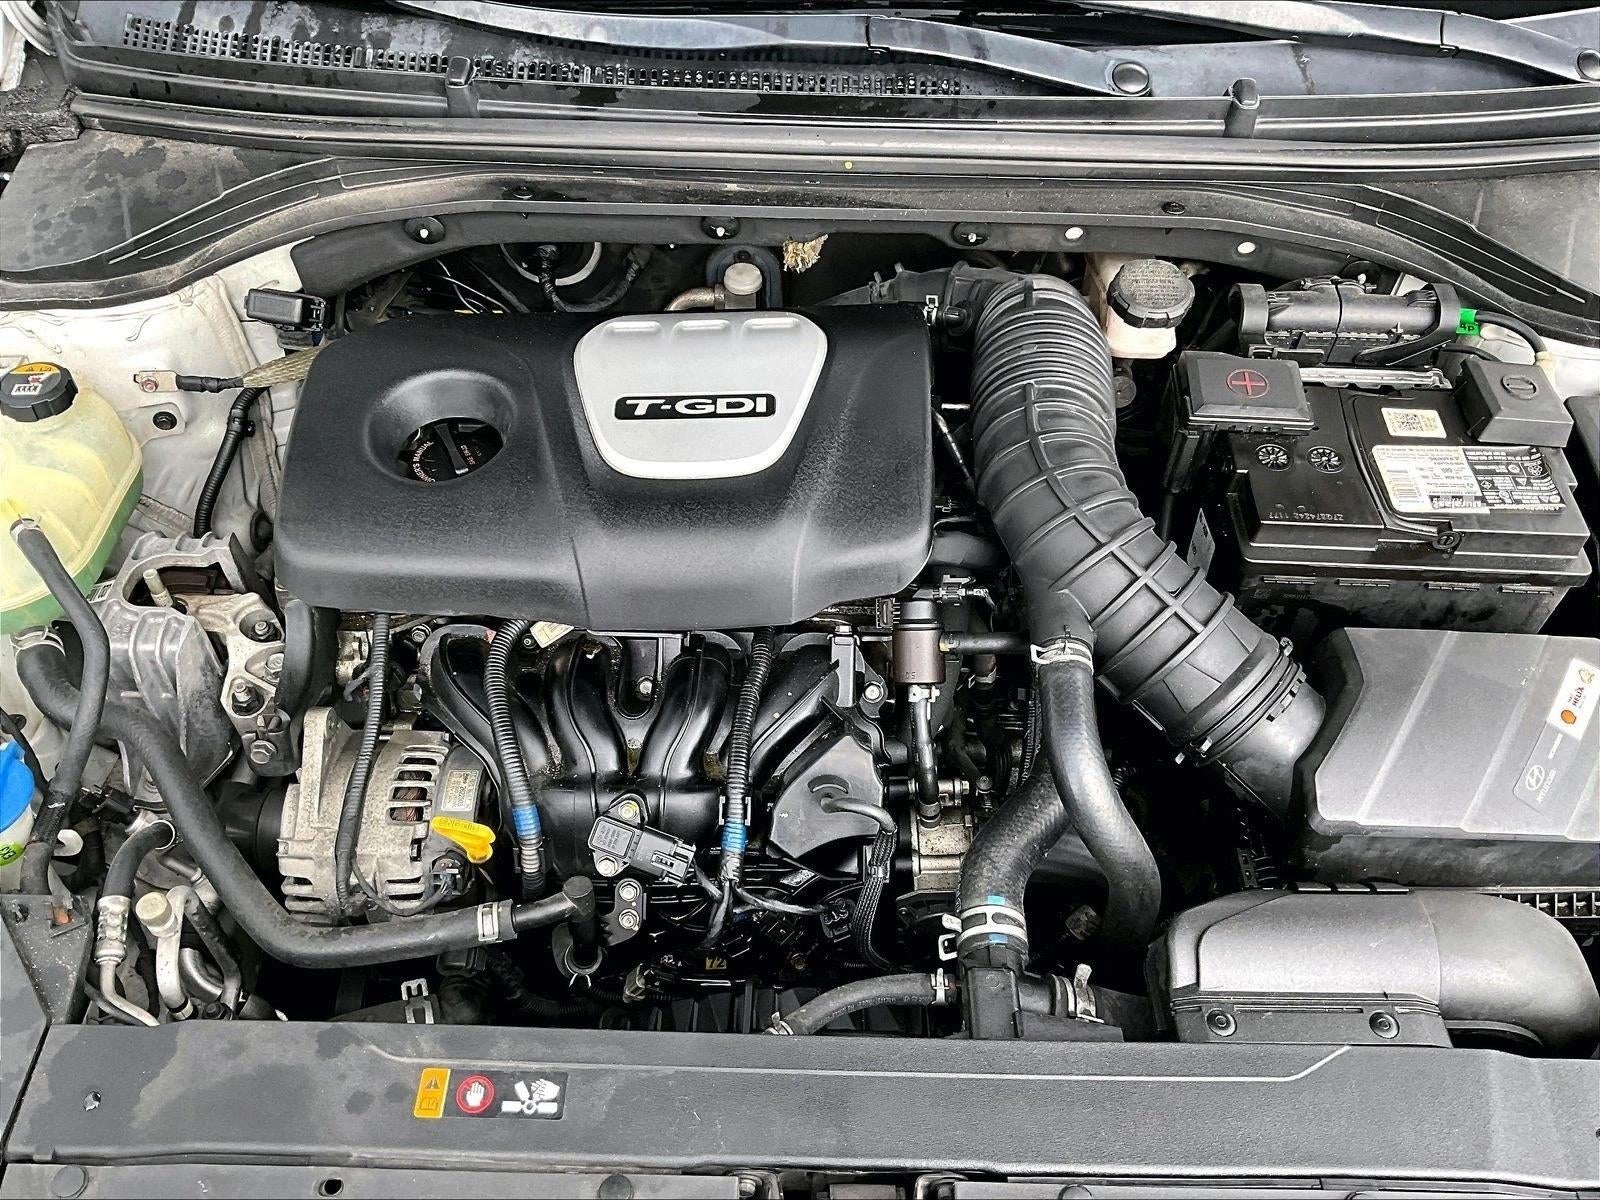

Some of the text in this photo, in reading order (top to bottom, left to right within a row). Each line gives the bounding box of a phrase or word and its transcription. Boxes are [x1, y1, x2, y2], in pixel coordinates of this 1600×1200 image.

[625, 396, 767, 416] T-GDI
[412, 441, 434, 461] MANUAL
[1572, 686, 1585, 706] HELIX
[1536, 769, 1557, 803] HYUNDAI
